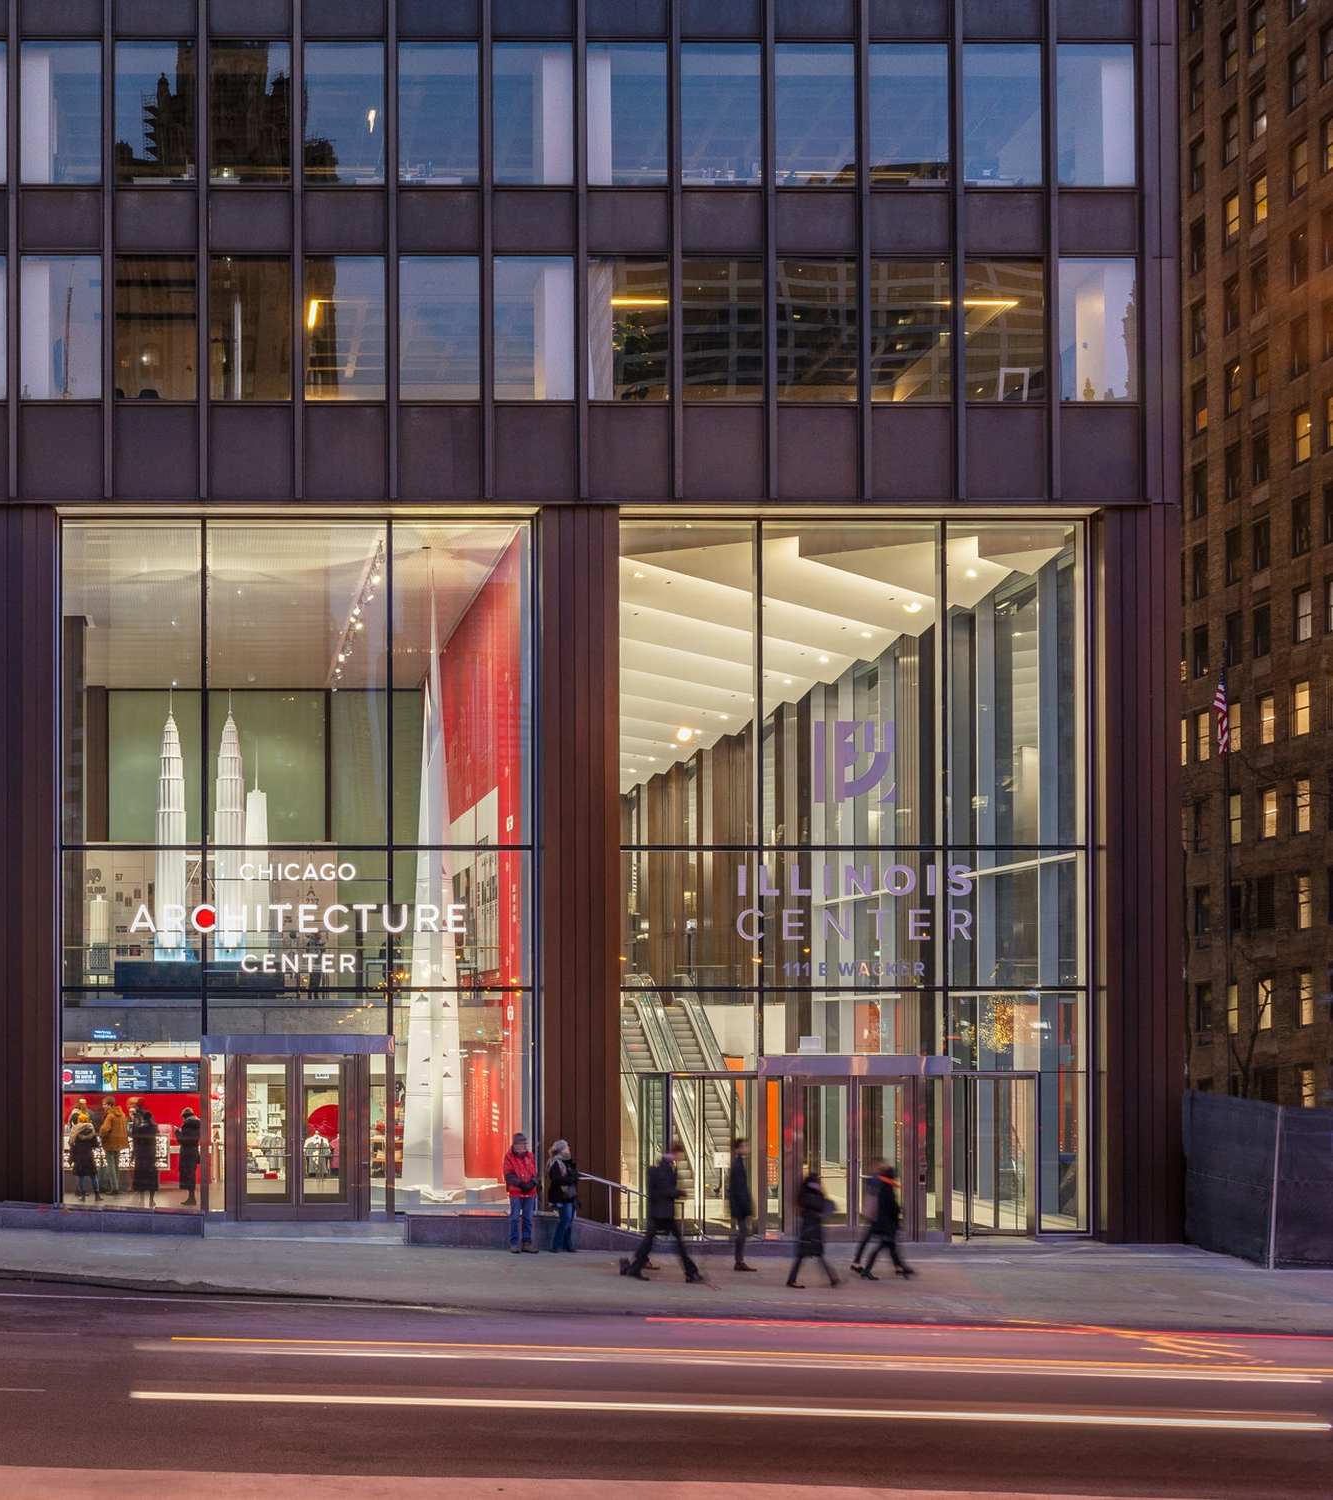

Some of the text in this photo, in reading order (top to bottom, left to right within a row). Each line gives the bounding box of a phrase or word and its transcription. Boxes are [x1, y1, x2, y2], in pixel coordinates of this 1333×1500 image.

[239, 862, 357, 881] CHICAGO
[737, 864, 974, 897] ILLINOIS
[130, 903, 468, 934] ARCHITECTURE
[736, 908, 973, 941] CENTER
[241, 953, 357, 973] CENTER
[782, 962, 926, 977] 111 E WACKER
